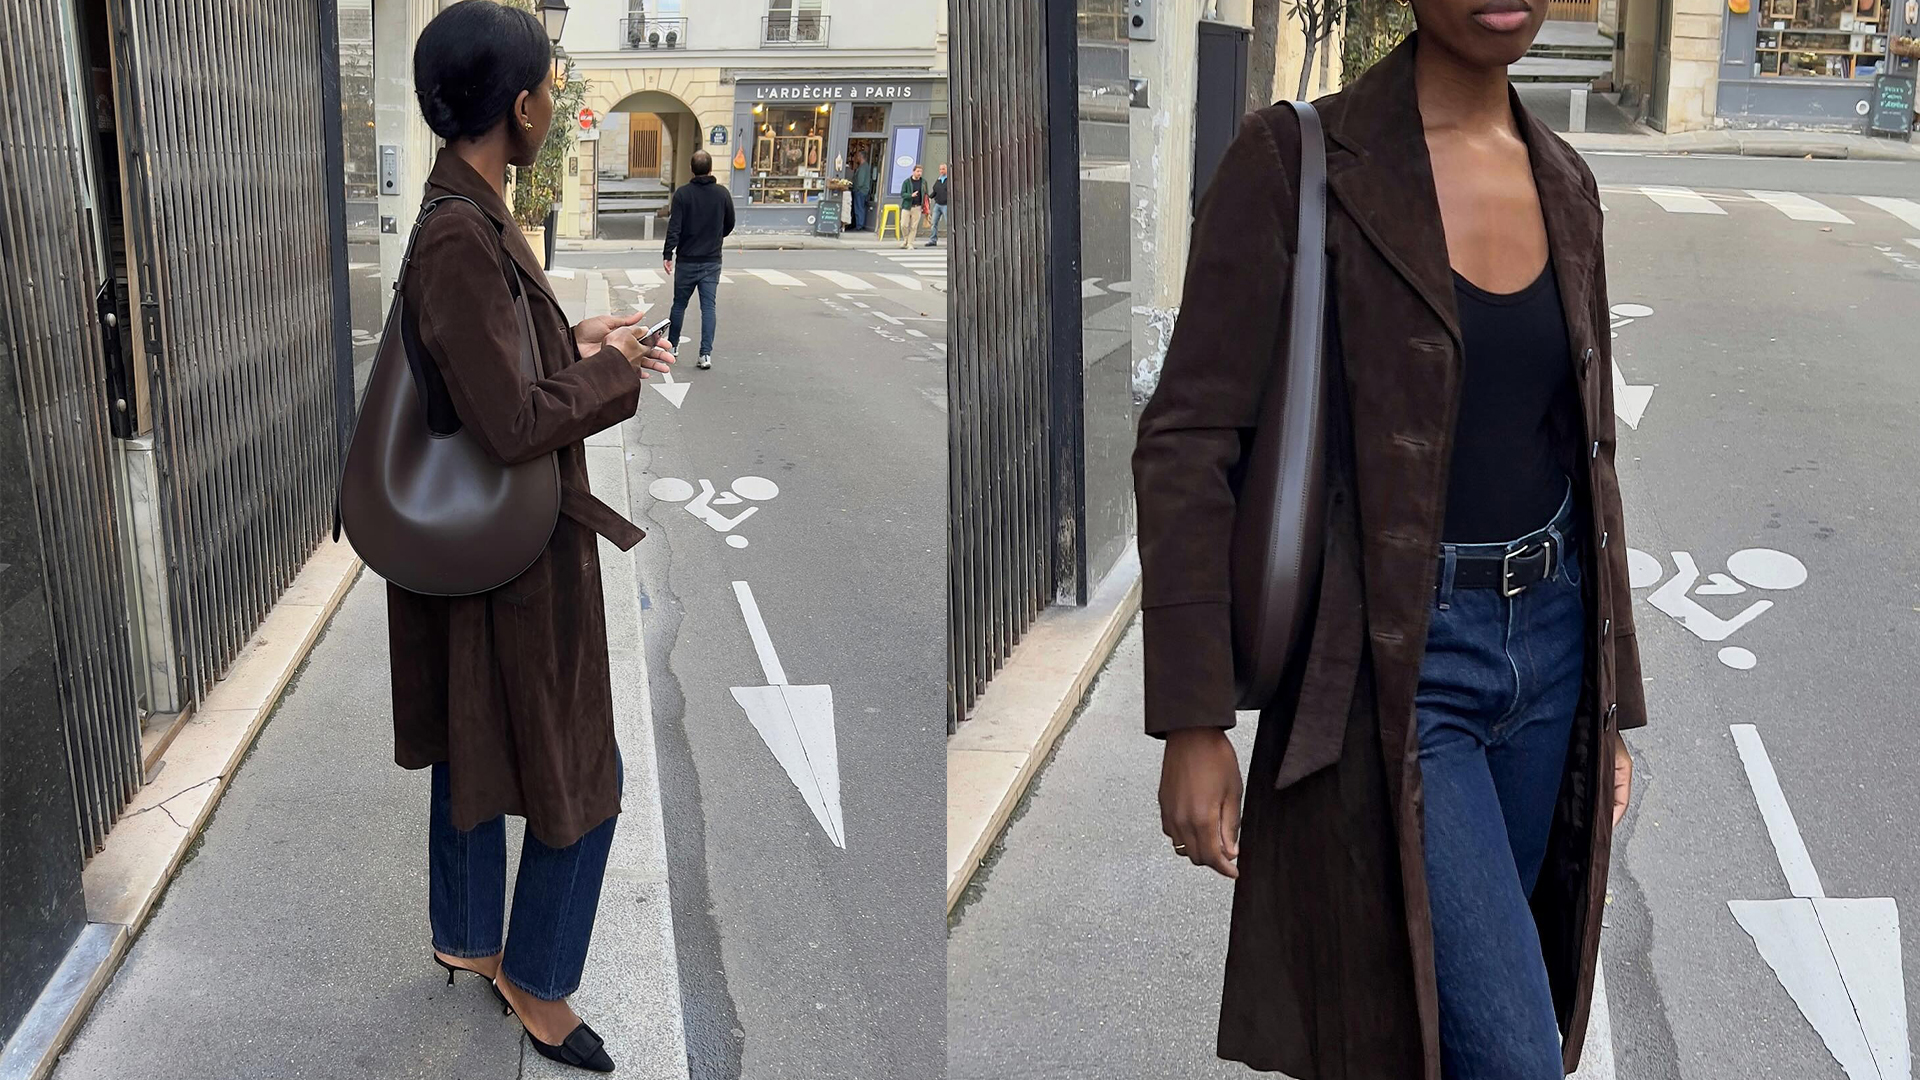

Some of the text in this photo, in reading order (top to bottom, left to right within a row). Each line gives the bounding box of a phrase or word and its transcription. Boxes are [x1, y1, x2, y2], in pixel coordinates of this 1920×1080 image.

[756, 85, 913, 98] L'ARDÈCHE à PARIS
